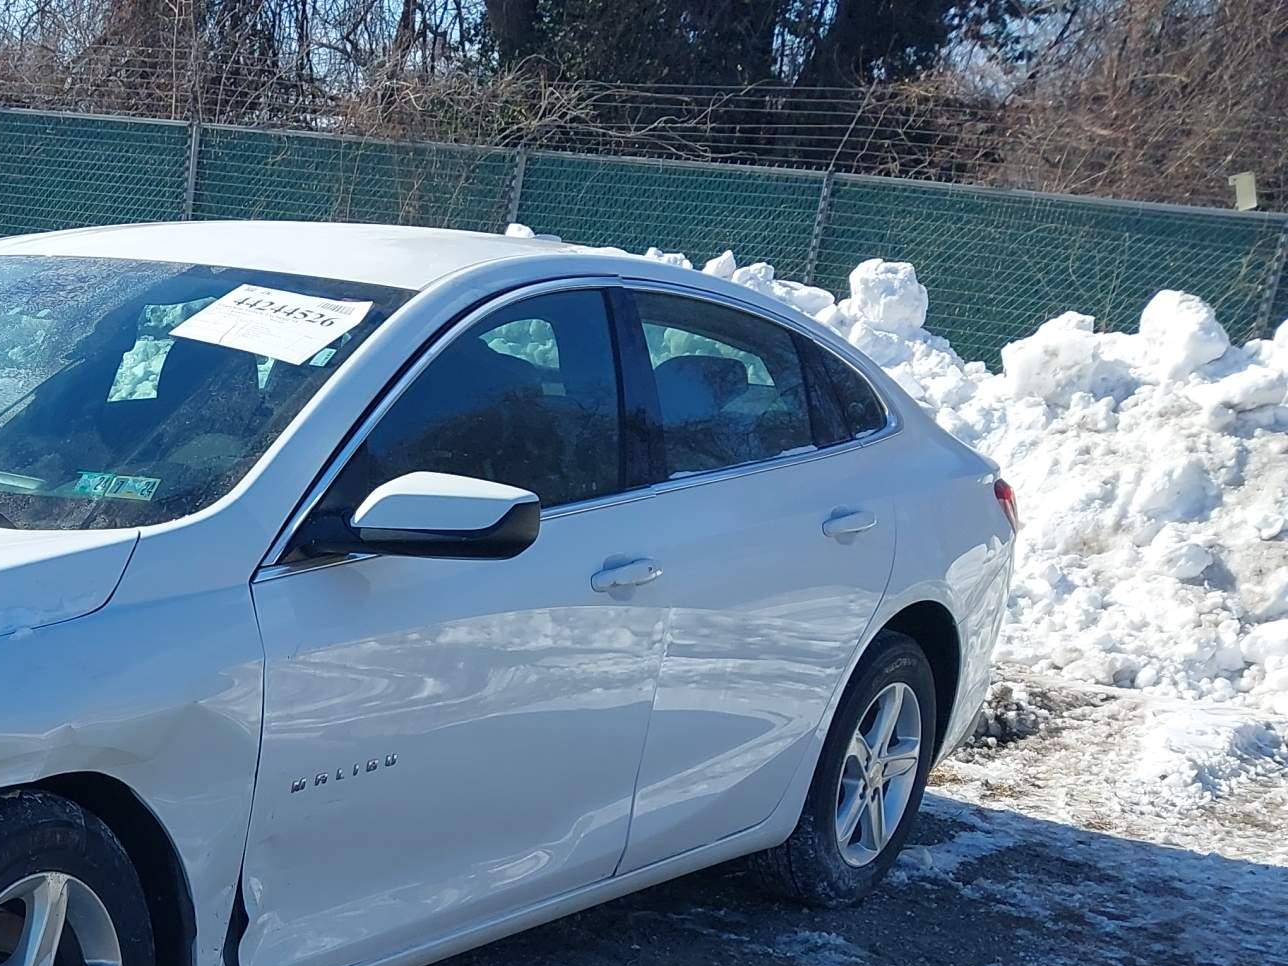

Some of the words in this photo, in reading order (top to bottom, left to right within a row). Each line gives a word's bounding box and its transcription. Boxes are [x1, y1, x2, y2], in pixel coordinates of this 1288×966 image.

[233, 296, 339, 328] 44244526
[140, 481, 156, 497] 24
[290, 752, 399, 793] MALIBU
